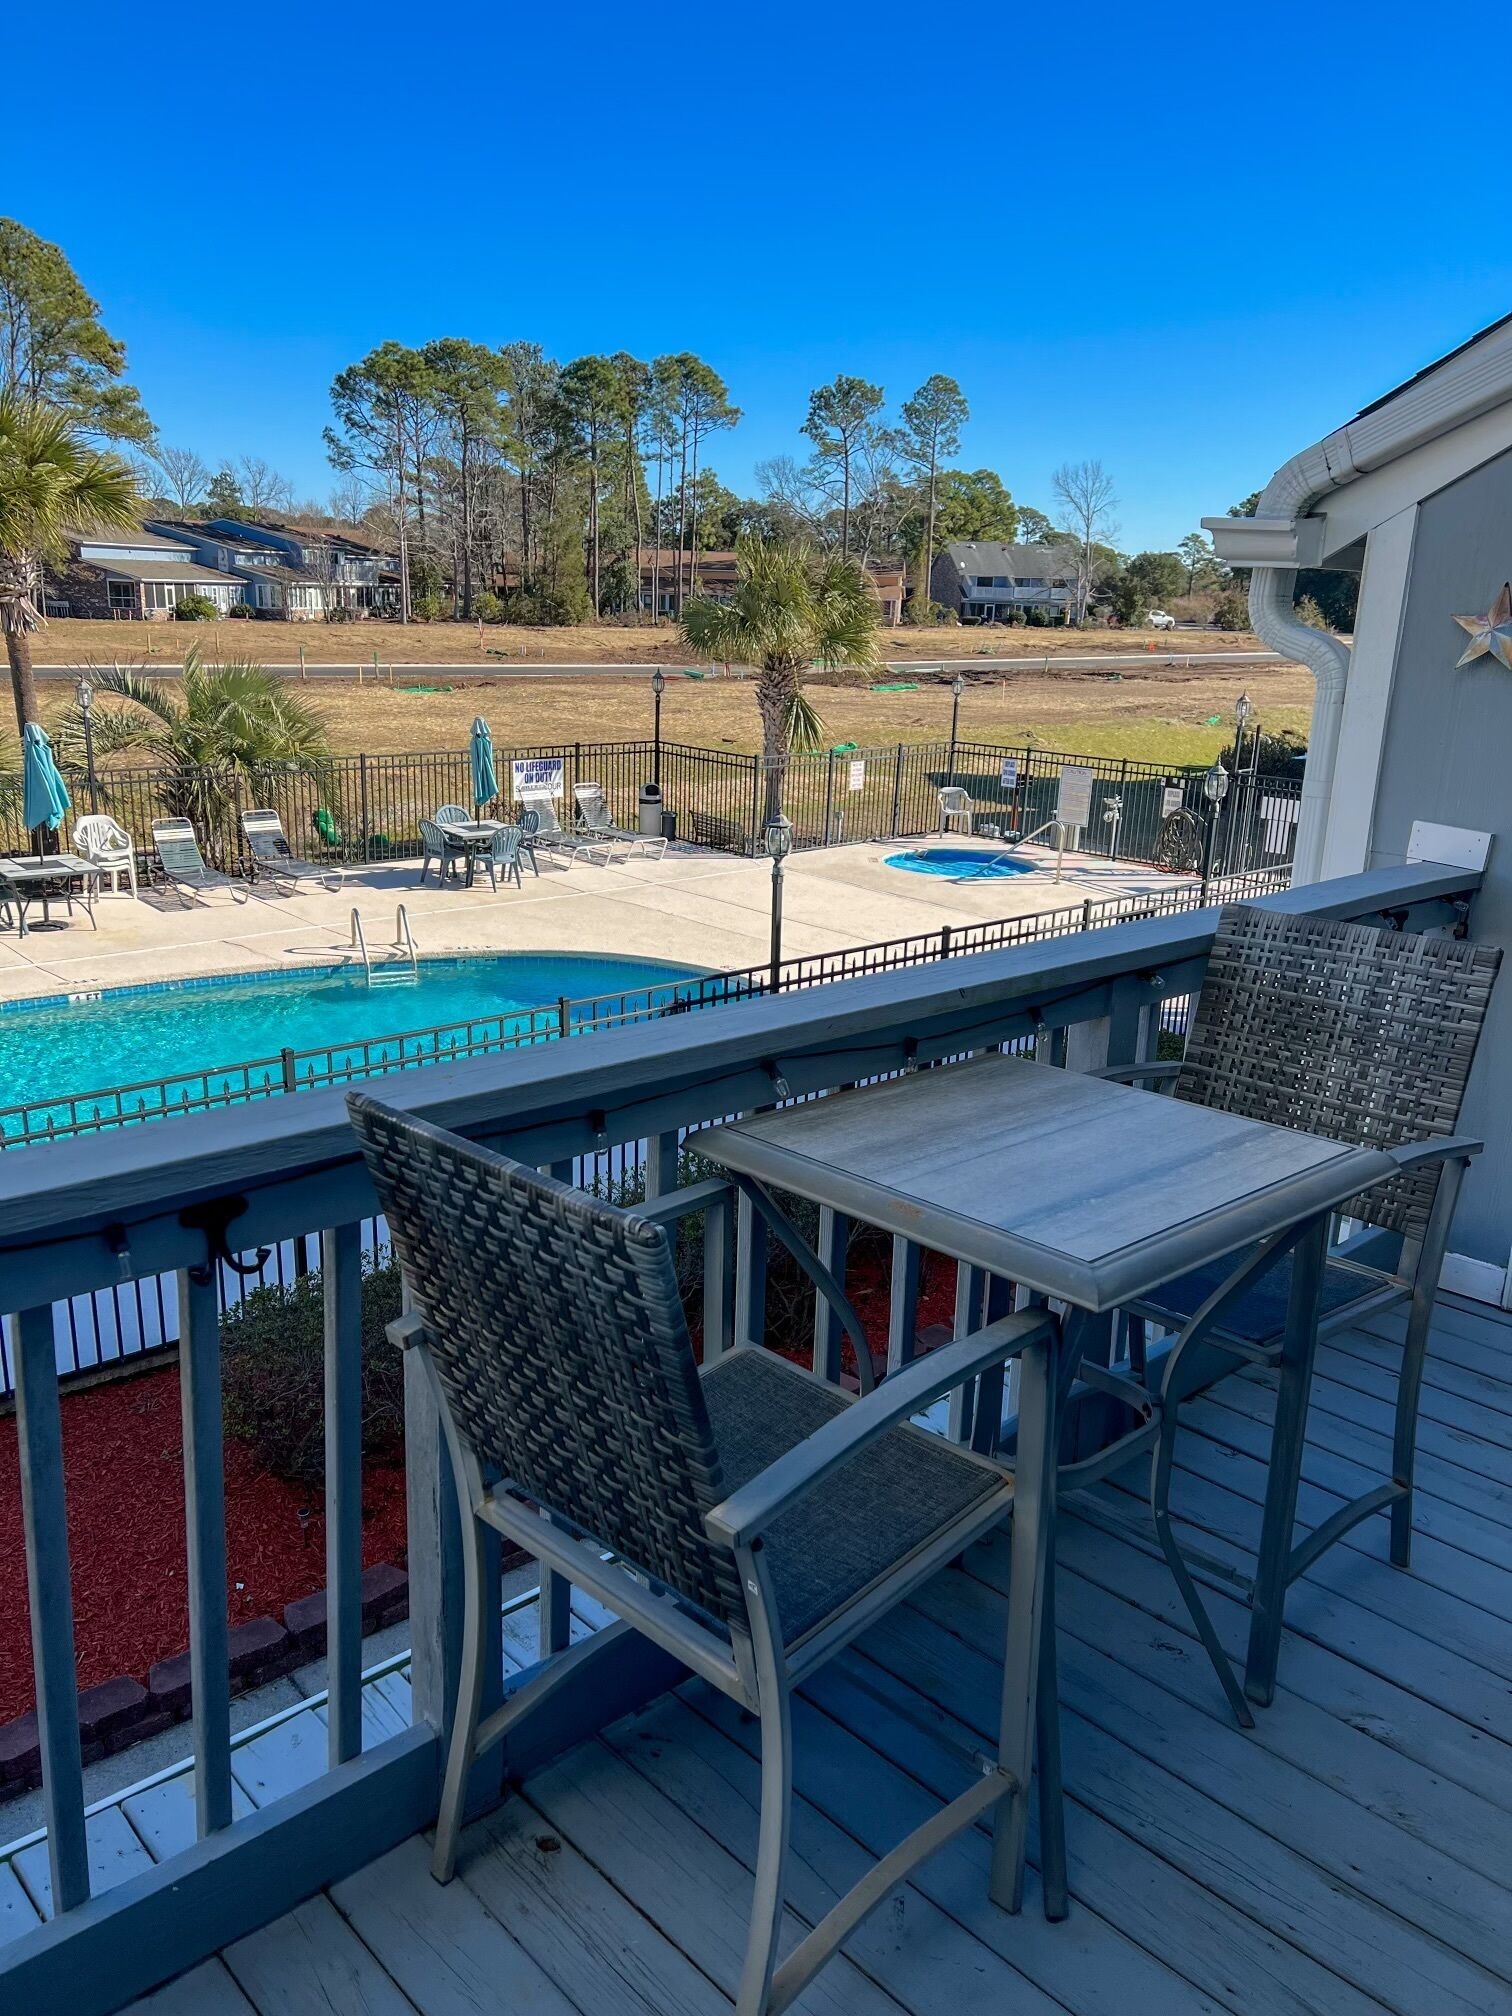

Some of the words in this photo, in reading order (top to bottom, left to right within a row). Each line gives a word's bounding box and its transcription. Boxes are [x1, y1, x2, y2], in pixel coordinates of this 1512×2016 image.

[515, 762, 524, 773] NO
[526, 760, 562, 772] LIFEGUARD
[524, 773, 533, 783] ON
[535, 772, 552, 782] DUTY
